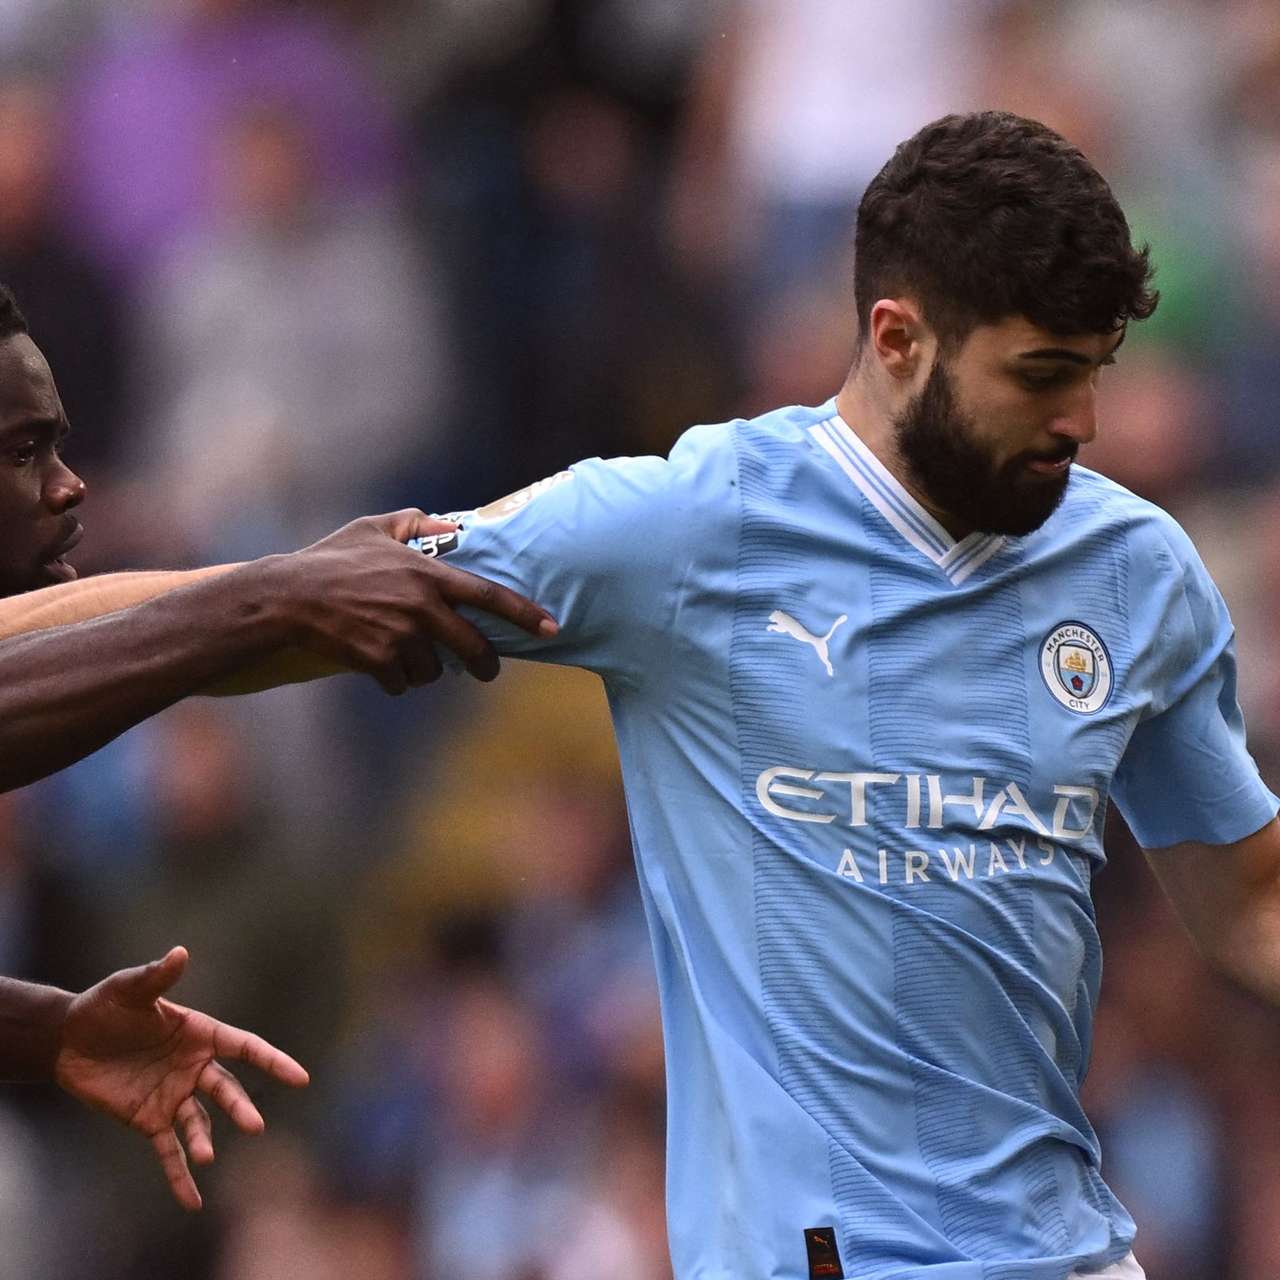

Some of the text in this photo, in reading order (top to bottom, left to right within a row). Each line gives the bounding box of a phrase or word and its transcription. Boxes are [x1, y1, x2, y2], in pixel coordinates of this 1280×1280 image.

[1046, 628, 1105, 663] MANCHESTER
[1068, 699, 1090, 710] CITY
[756, 766, 1100, 838] ETIHAD
[835, 838, 1055, 884] AIRWAYS
